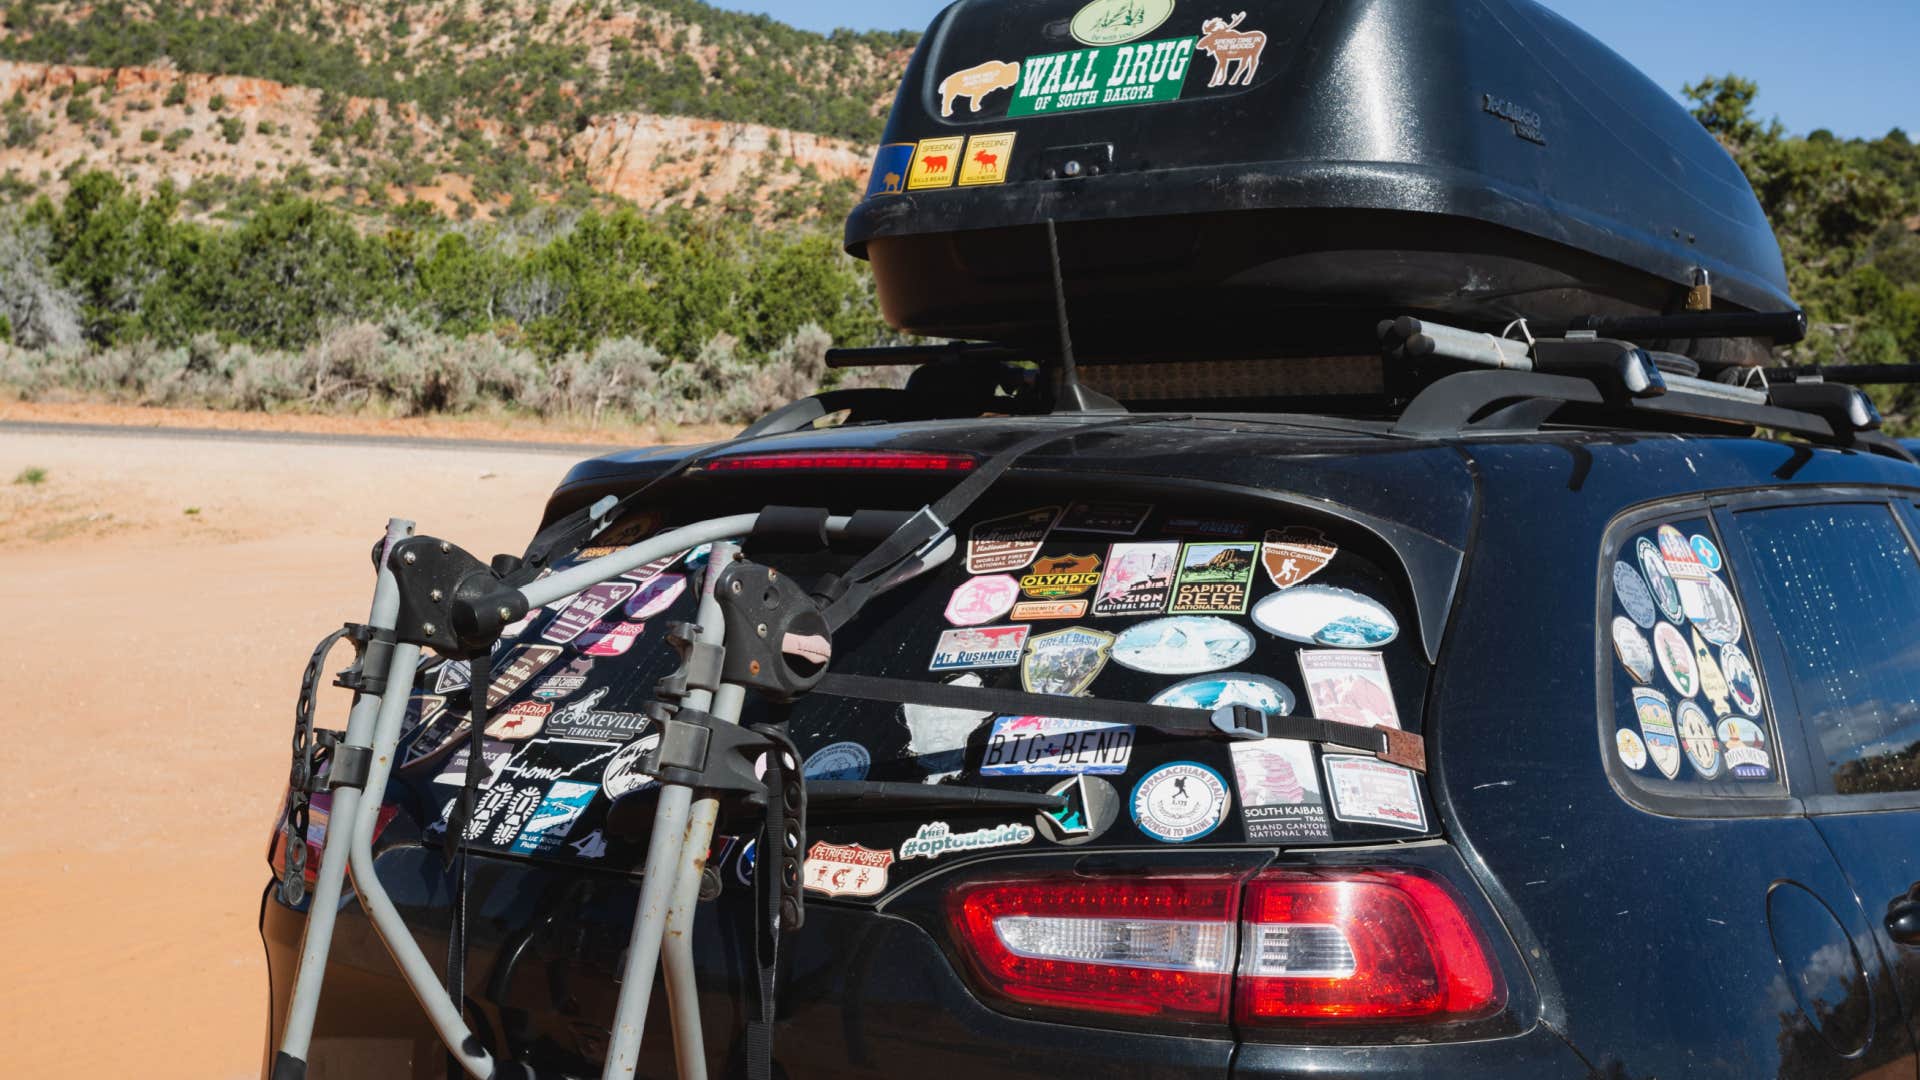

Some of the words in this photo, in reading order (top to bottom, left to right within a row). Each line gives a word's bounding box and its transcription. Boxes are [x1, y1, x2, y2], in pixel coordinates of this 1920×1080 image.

[1020, 51, 1100, 98] WALL
[1106, 38, 1191, 87] DRUG
[1034, 97, 1051, 110] OF
[1056, 91, 1099, 109] SOUTH
[1102, 85, 1154, 103] DAKOTA
[922, 143, 956, 153] SPEEDING
[972, 139, 1008, 148] SPEEDING
[1265, 547, 1289, 556] South
[1290, 551, 1326, 564] Carolina
[1023, 574, 1097, 586] OLYMPIC
[1180, 585, 1243, 593] CAPITOL
[1126, 594, 1163, 603] ZION
[1177, 593, 1243, 605] REEF
[1097, 603, 1137, 611] NATIONAL
[1039, 633, 1072, 649] GREAT
[957, 650, 1020, 663] RUSHMORE
[551, 710, 648, 731] COOKEVILLE
[567, 727, 613, 738] TENNESSEE
[986, 731, 1045, 766] BIG
[1060, 730, 1134, 764] BEND
[1140, 766, 1208, 796] APPALACHIAN
[1207, 775, 1225, 801] TRAIL
[1244, 807, 1284, 818] SOUTH
[1285, 806, 1325, 816] KAIBAB
[1304, 815, 1327, 823] TRAIL
[1173, 828, 1184, 837] TO
[1185, 818, 1212, 836] MAINE
[1248, 823, 1283, 832] GRAND
[1249, 830, 1301, 838] NATIONAL
[1304, 829, 1329, 837] PARK
[519, 833, 540, 842] BLUE
[904, 827, 1030, 857] #optoutside
[815, 846, 856, 860] PETRIFIED
[856, 851, 890, 863] FOREST
